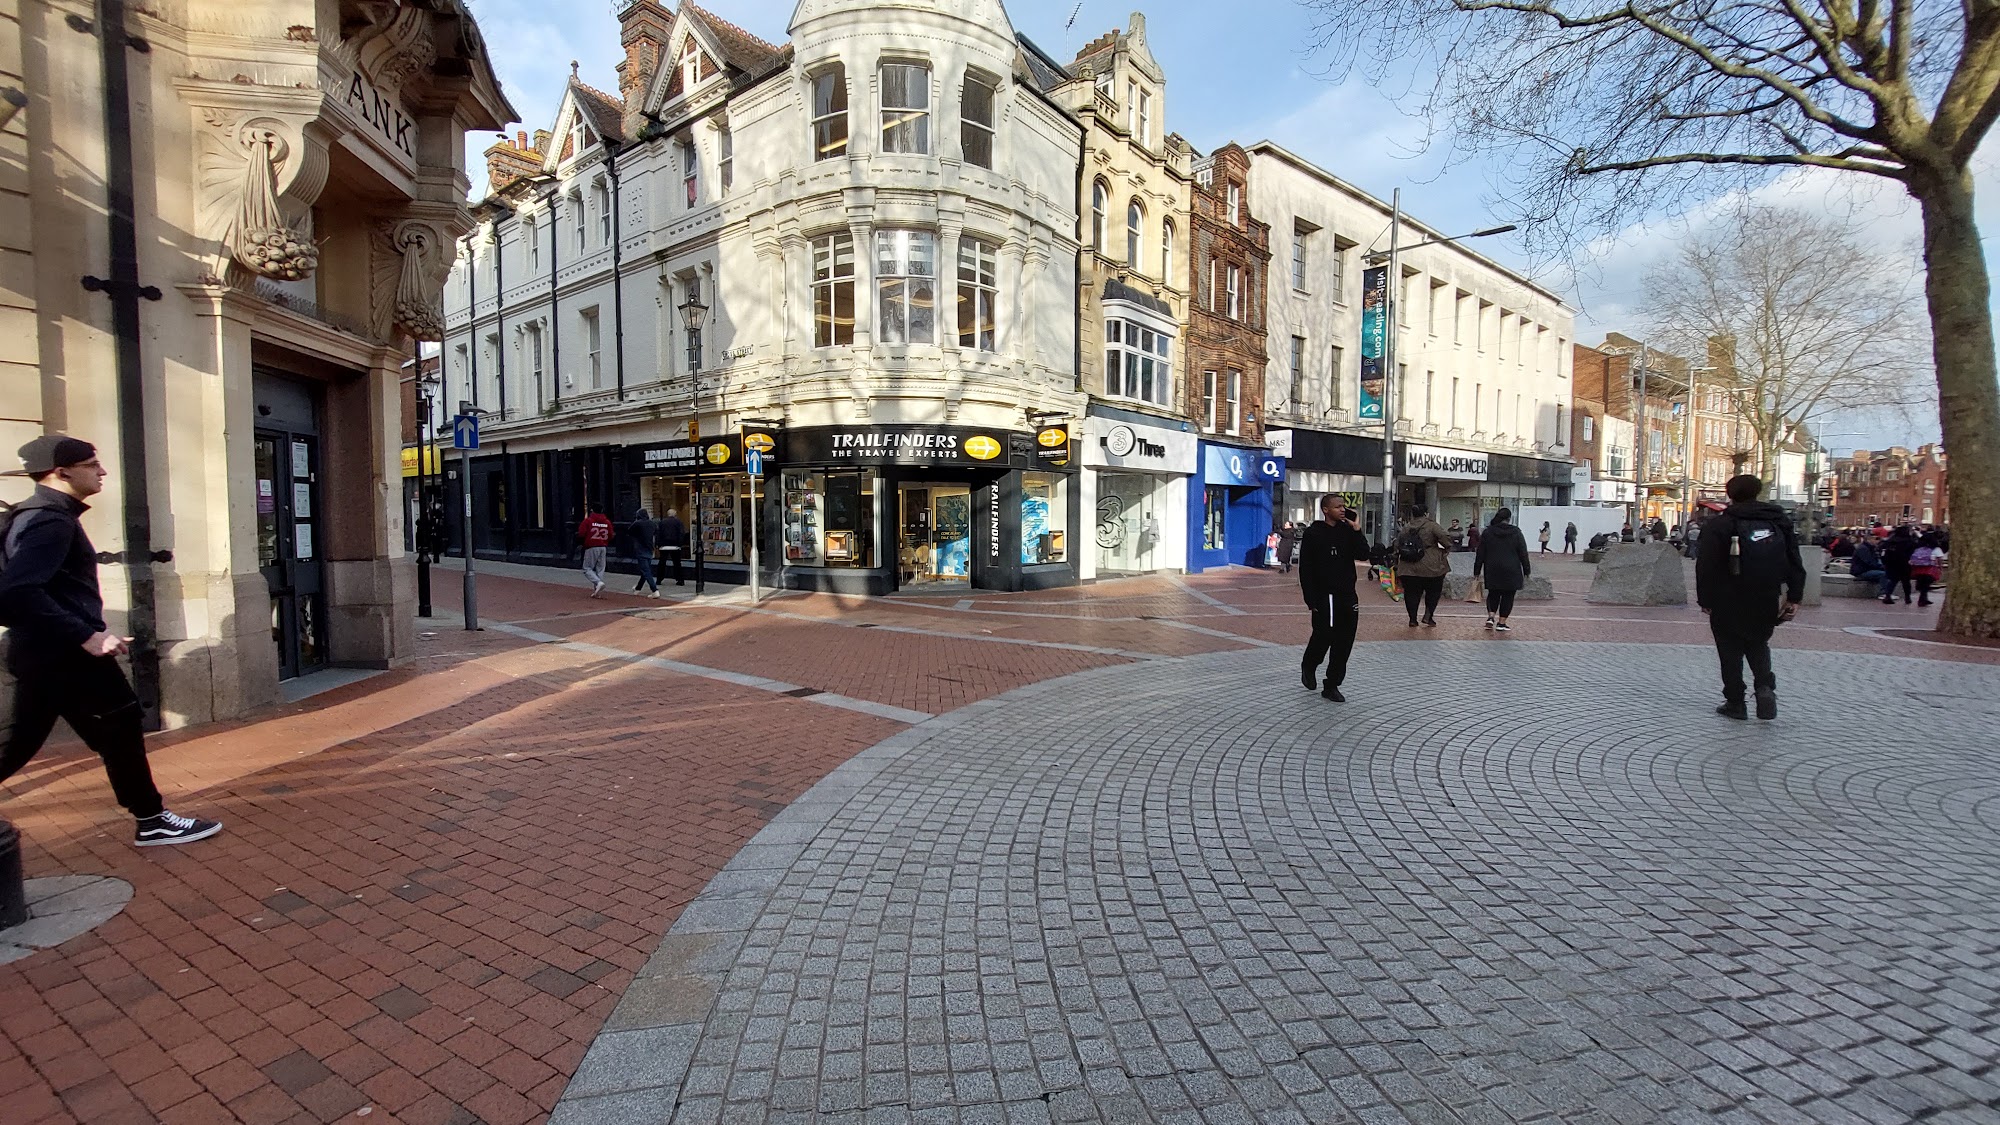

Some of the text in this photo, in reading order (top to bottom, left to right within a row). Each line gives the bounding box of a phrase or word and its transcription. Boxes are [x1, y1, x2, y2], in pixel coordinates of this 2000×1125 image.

[346, 70, 413, 158] ANK
[1373, 271, 1386, 358] visit-reading.com
[832, 433, 958, 448] TRAILFINDERS
[1137, 437, 1166, 459] Three
[1269, 440, 1286, 448] M&S
[858, 449, 901, 457] TRAVEL
[908, 450, 958, 458] EXPERTS
[1409, 452, 1487, 475] MARKS & SPENCER
[991, 480, 999, 557] TRAILFINDERS
[590, 527, 609, 541] 23
